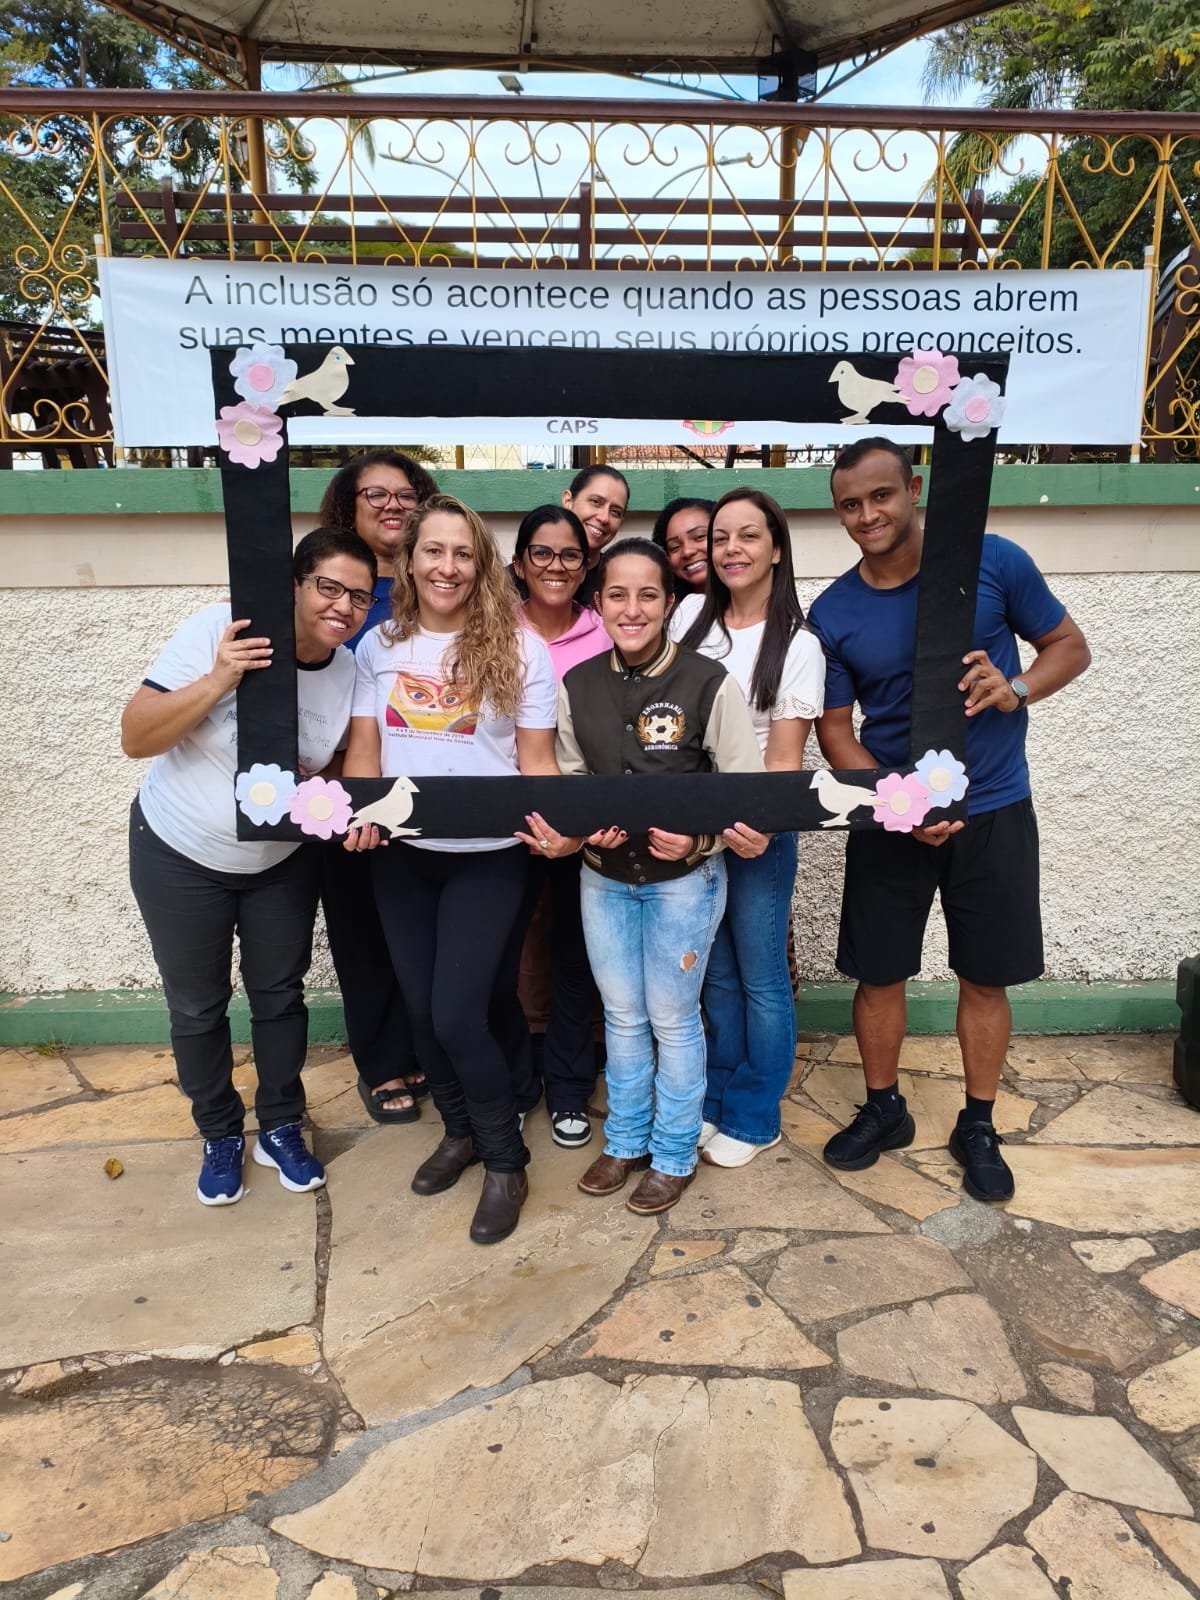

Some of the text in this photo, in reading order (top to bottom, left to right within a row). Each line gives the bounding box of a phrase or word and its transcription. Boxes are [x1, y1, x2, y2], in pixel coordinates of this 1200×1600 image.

[185, 274, 1078, 318] A inclusão só acontece quando as pessoas abrem
[179, 323, 1082, 354] suas mentes e vencem seus próprios preconceitos.
[546, 419, 599, 434] CAPS
